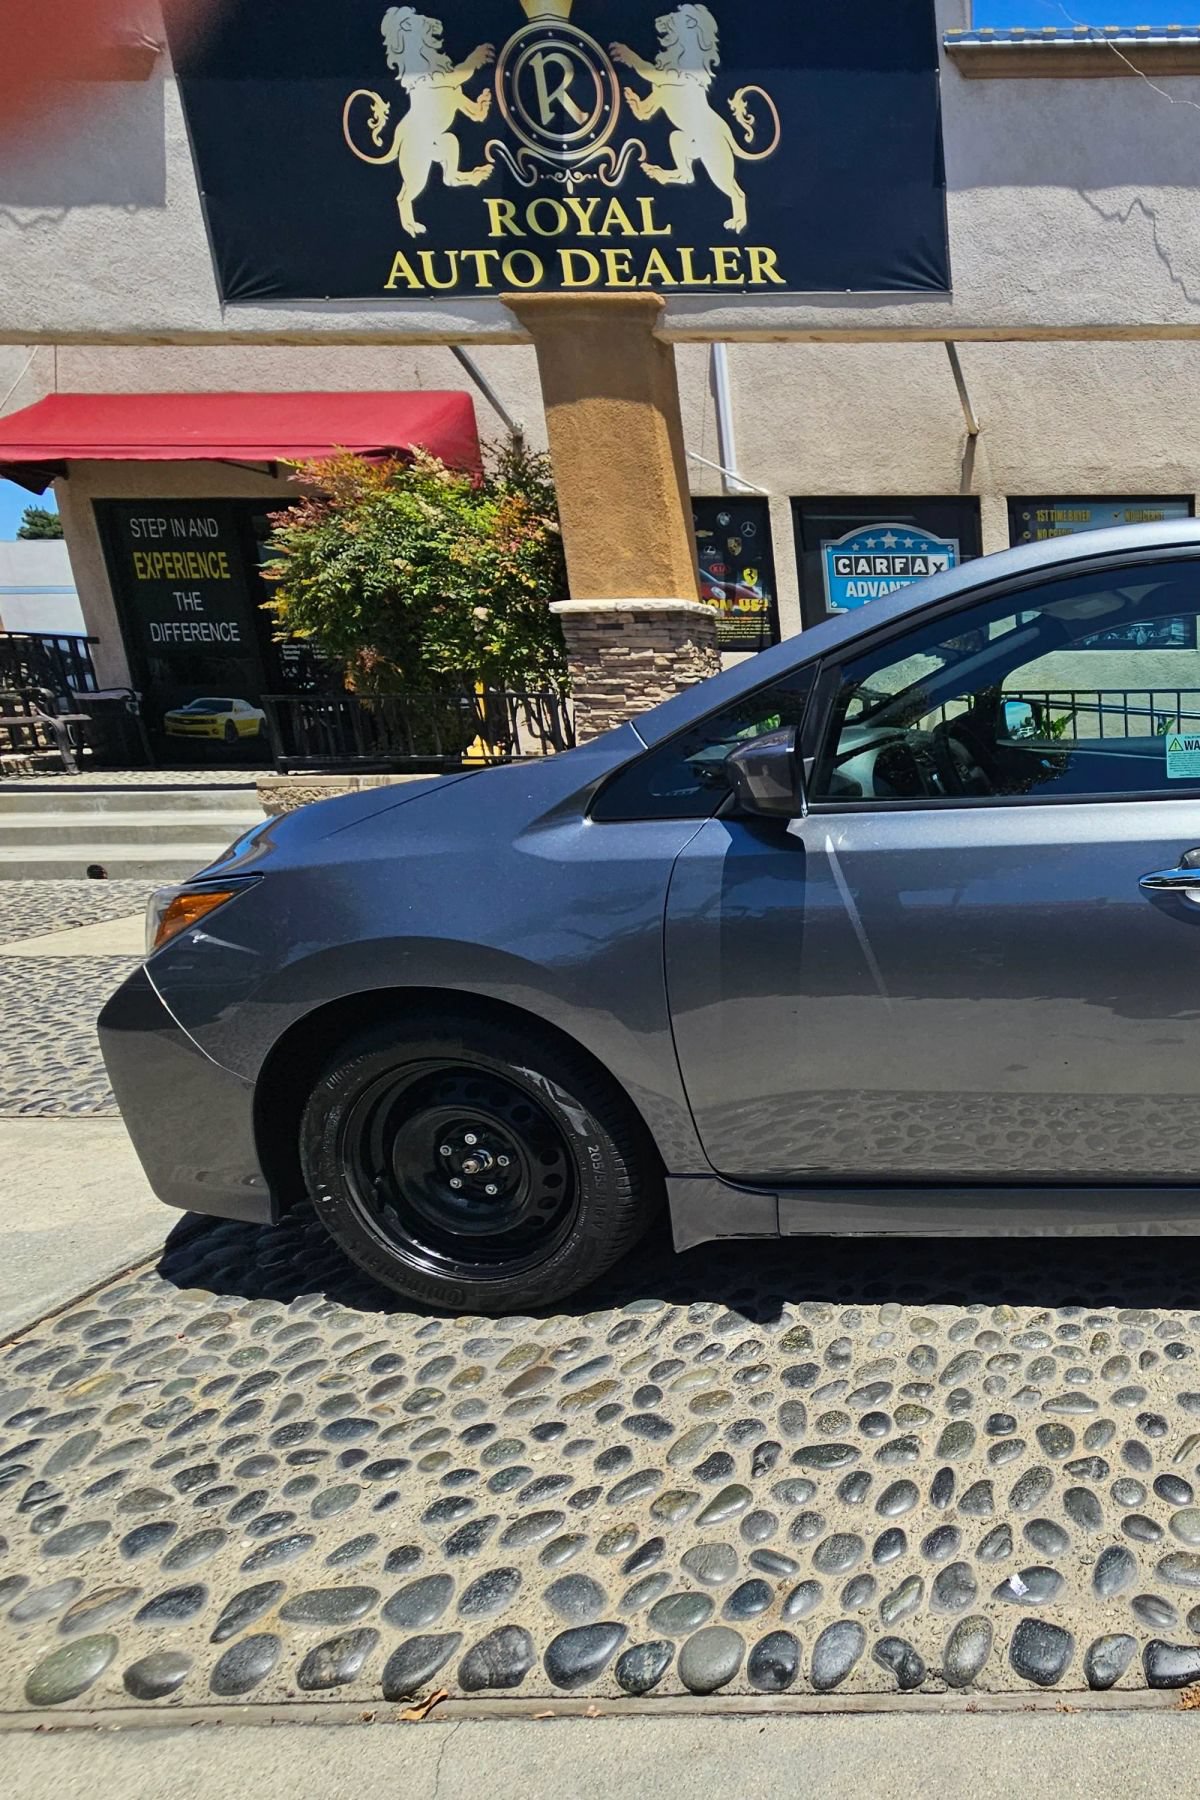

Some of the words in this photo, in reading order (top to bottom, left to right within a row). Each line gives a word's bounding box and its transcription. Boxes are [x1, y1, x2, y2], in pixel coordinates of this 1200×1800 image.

[529, 52, 589, 126] R
[482, 196, 672, 237] ROYAL
[383, 248, 545, 289] AUTO
[556, 245, 787, 288] DEALER
[130, 518, 167, 538] STEP
[170, 518, 186, 537] IN
[189, 518, 219, 537] AND
[133, 551, 231, 579] EXPERIENCE
[837, 558, 945, 574] CARFAX
[172, 592, 204, 611] THE
[149, 622, 241, 642] DIFFERENCE
